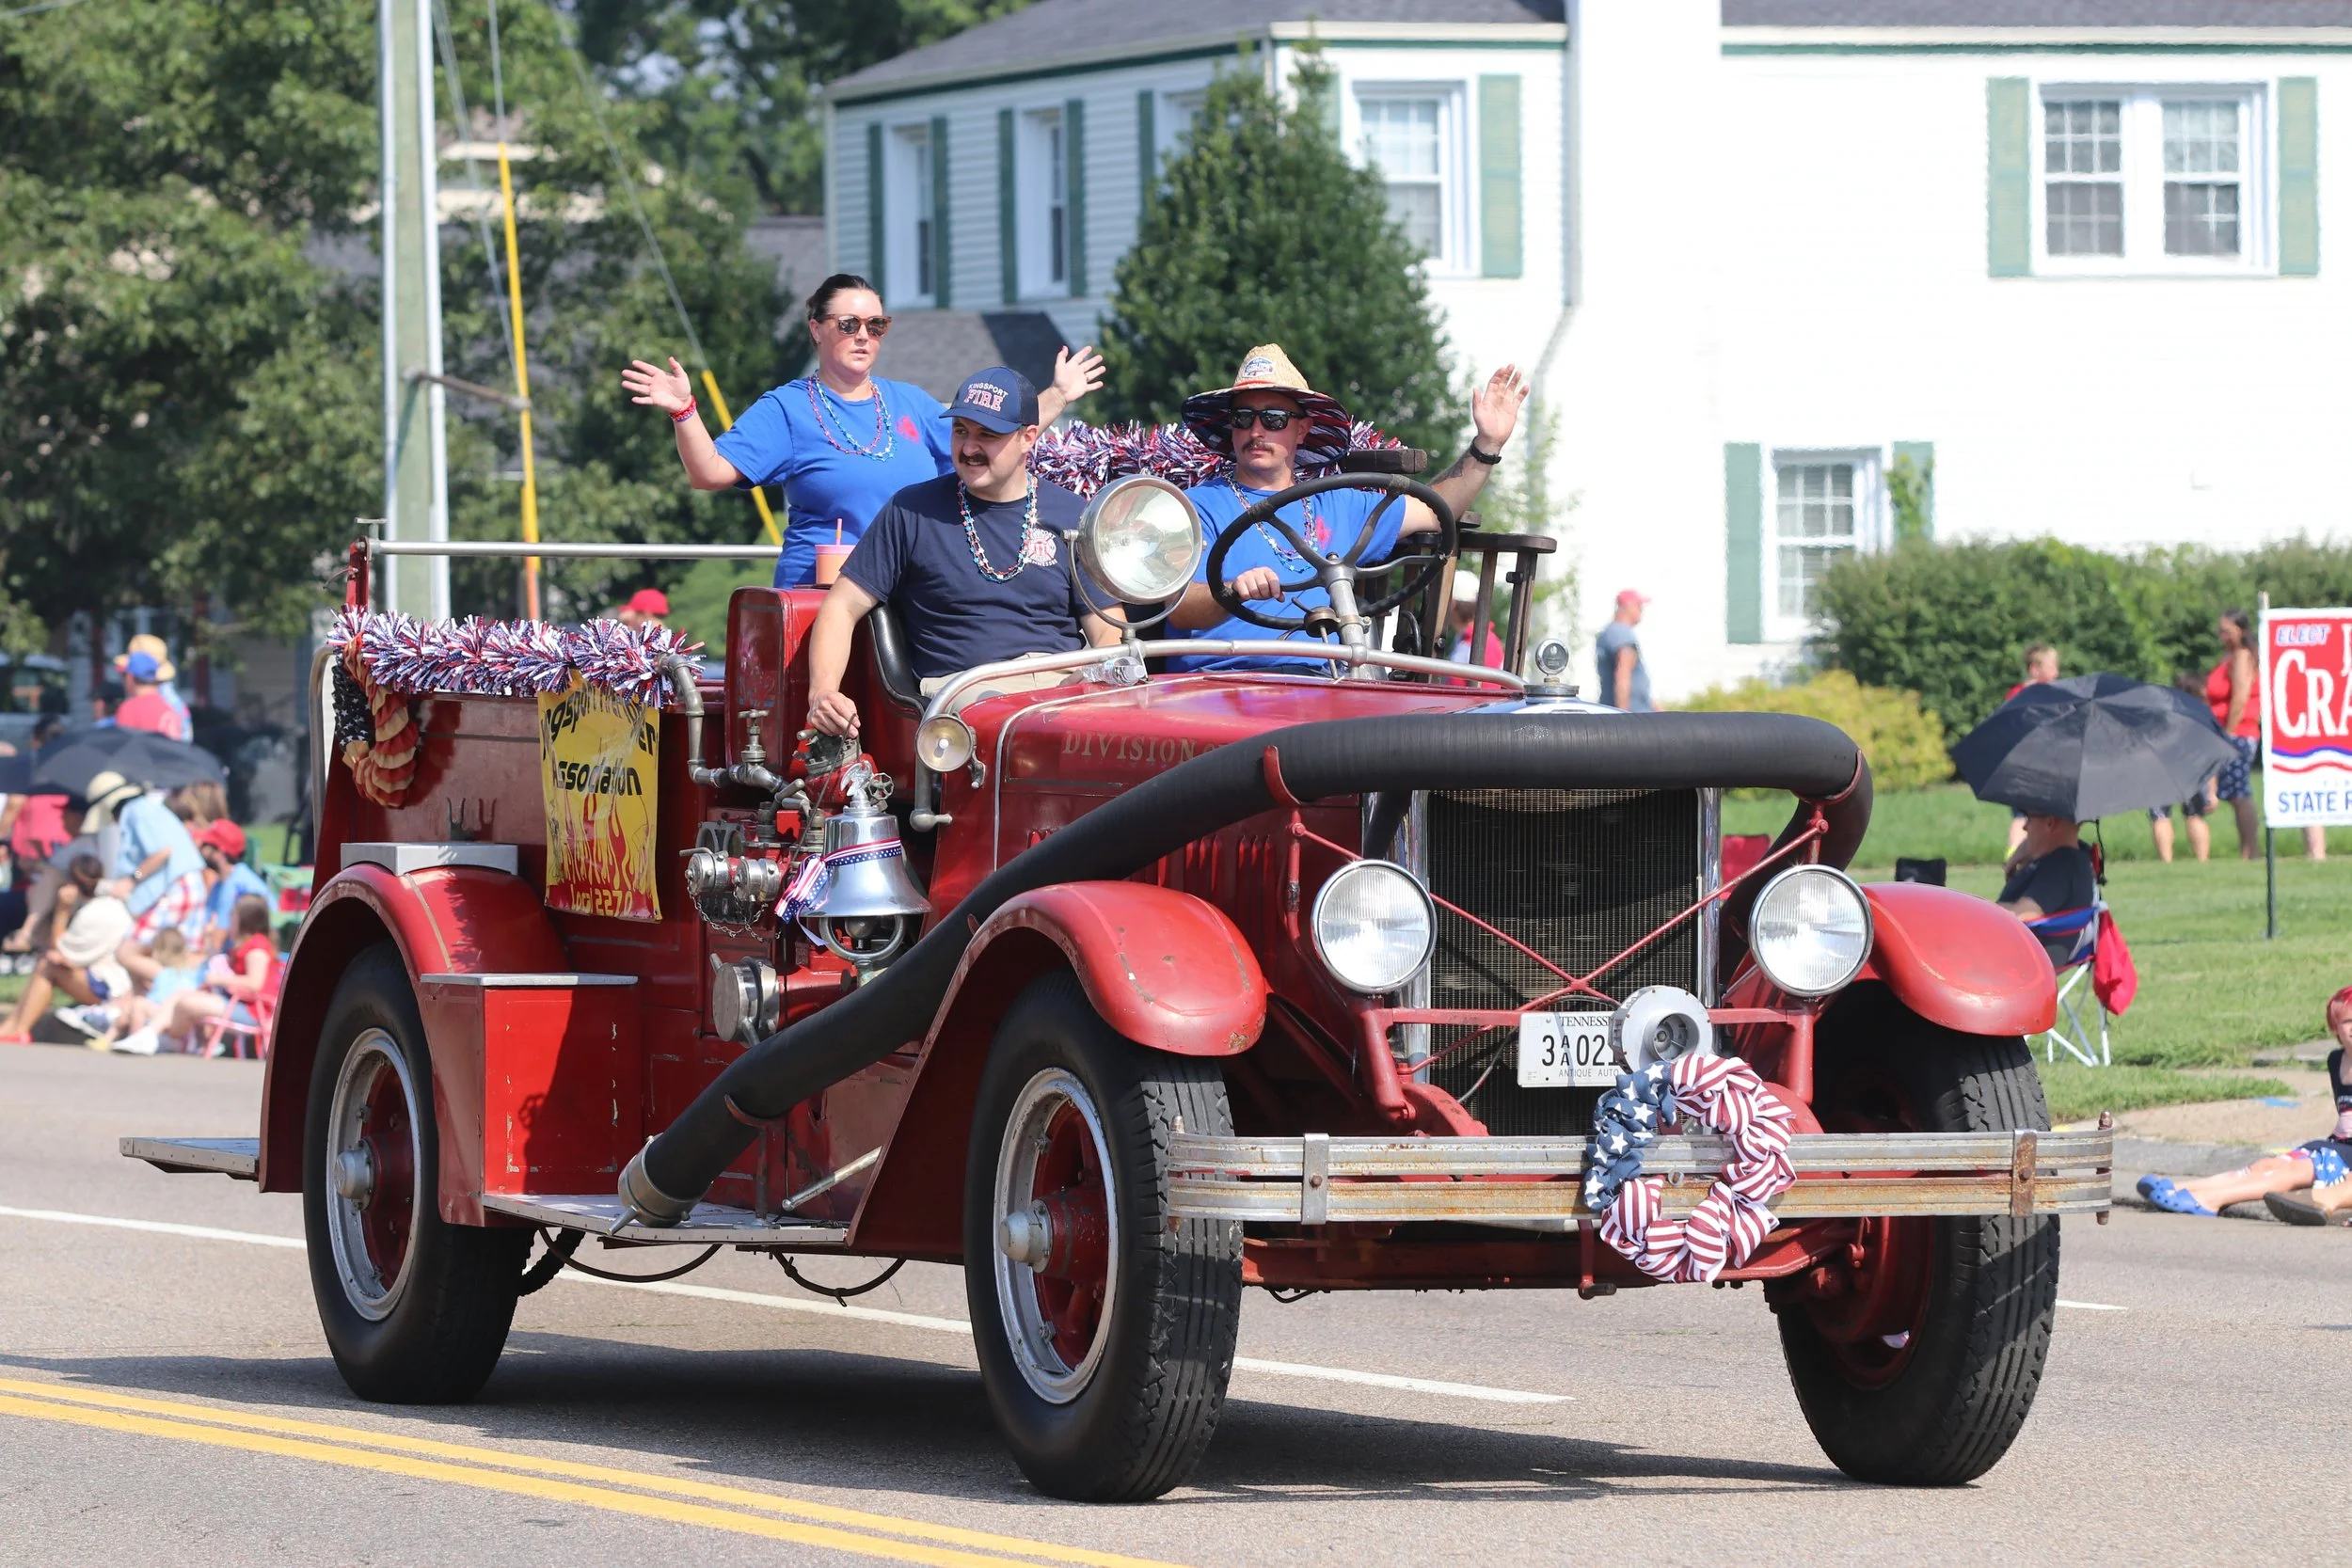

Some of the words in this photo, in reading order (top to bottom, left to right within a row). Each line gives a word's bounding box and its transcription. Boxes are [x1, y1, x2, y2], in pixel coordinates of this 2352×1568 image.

[963, 388, 1004, 412] FIRE
[967, 382, 1009, 397] KINGSPORT
[2277, 625, 2330, 645] ELECT
[1061, 730, 1197, 763] DIVISION
[2279, 790, 2338, 814] STATE
[595, 888, 633, 918] 2270
[1560, 1016, 1611, 1027] TENNESS
[1559, 1069, 1592, 1078] ANTIQUE
[1597, 1069, 1619, 1078] AUTO
